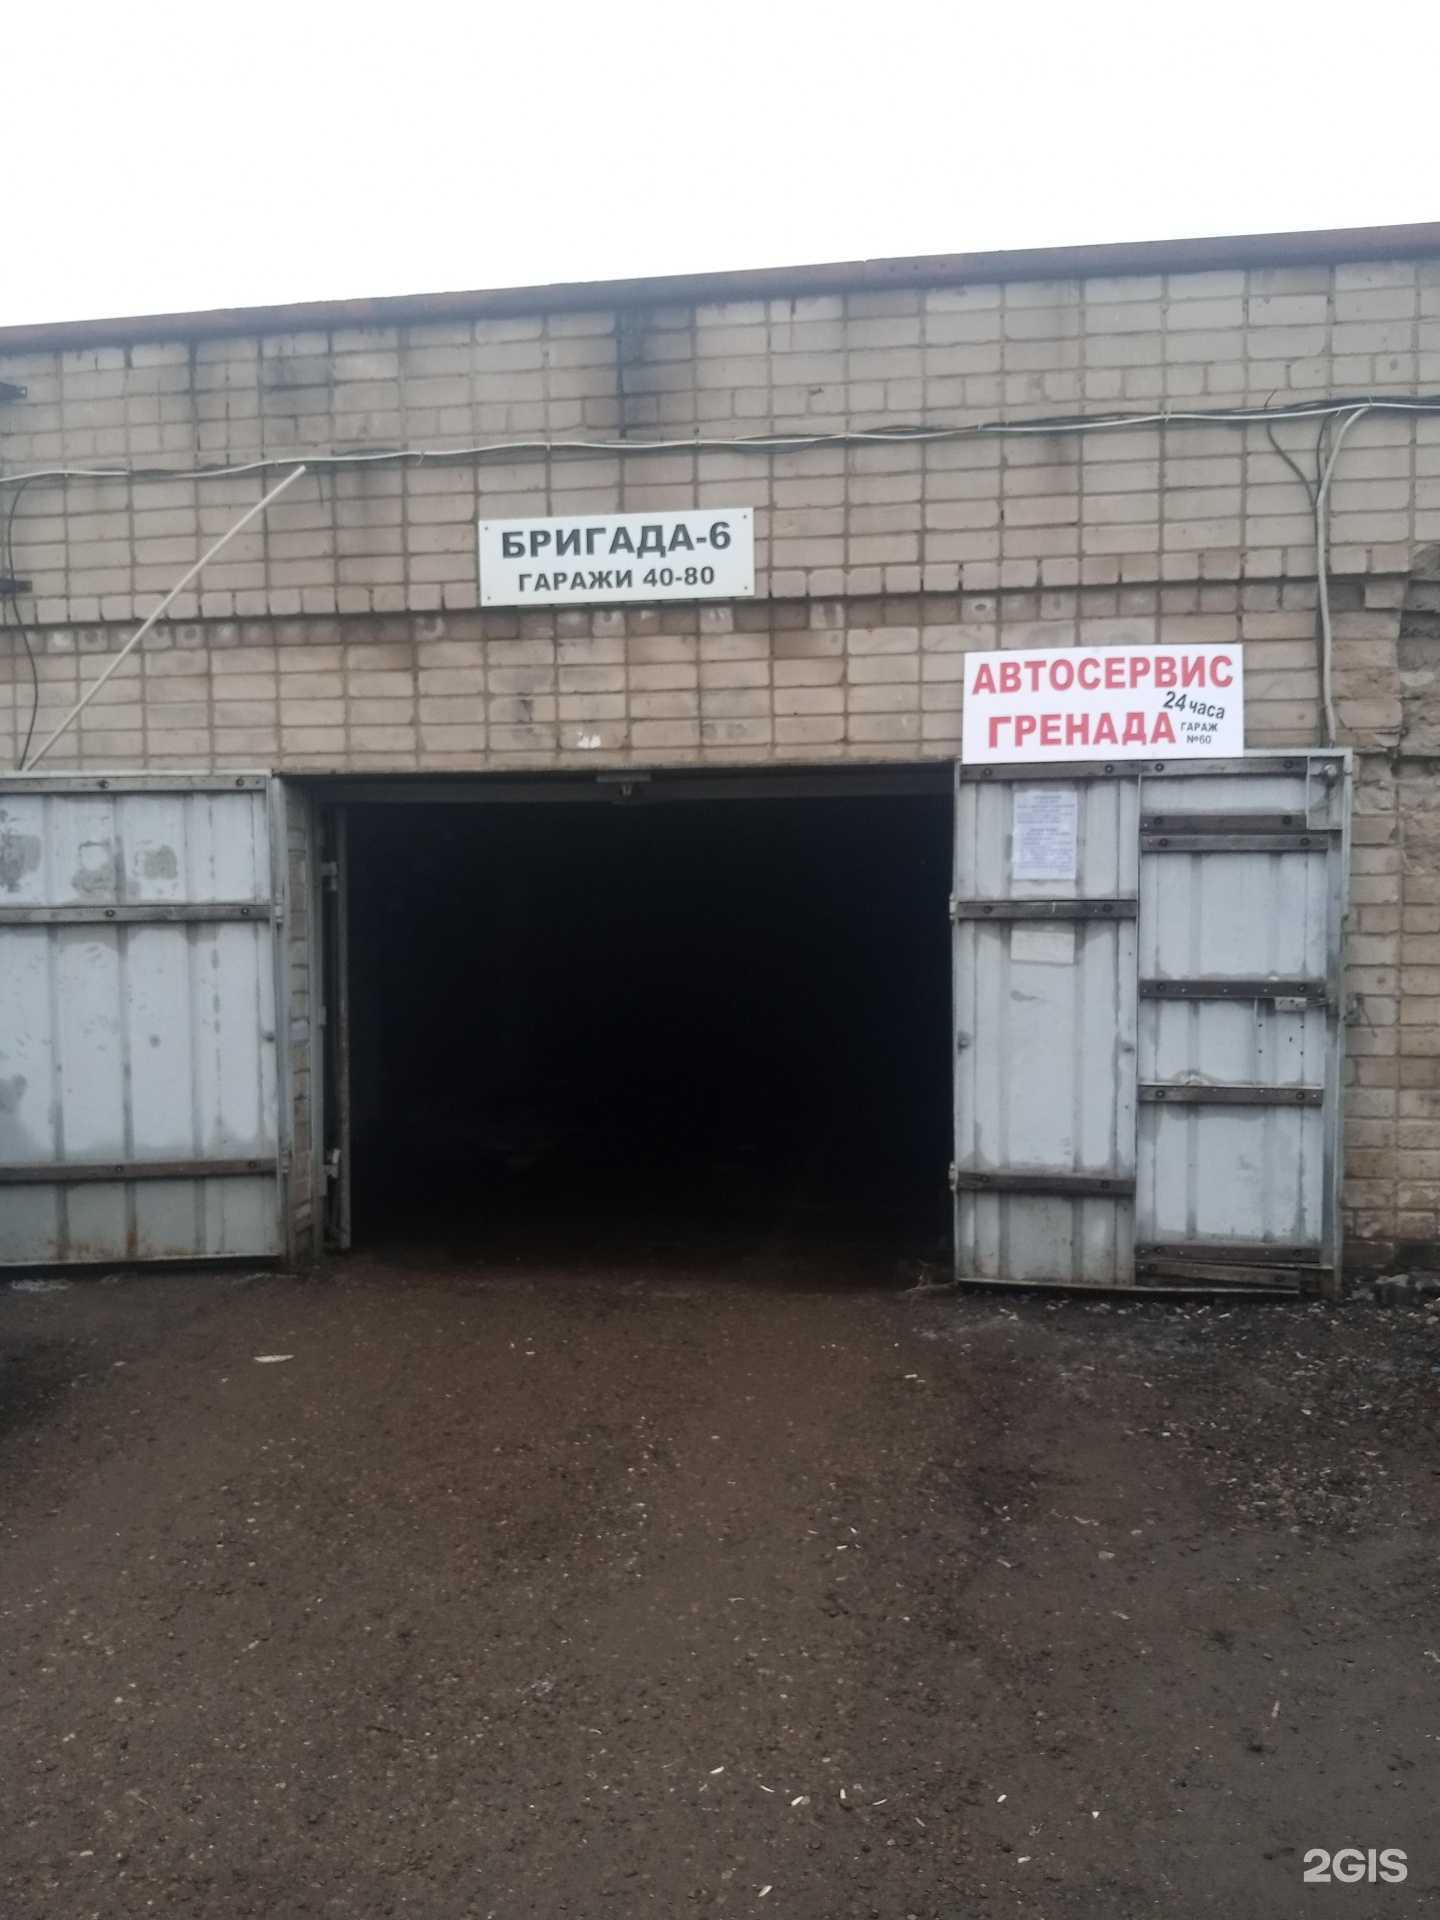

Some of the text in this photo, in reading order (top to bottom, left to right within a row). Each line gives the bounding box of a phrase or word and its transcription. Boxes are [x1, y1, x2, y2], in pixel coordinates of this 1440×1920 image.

[502, 522, 731, 559] БРИГАДА-6
[518, 566, 715, 592] ГАРАЖИ 40-80
[972, 655, 1234, 695] АВТОСЕРВИС
[1163, 691, 1225, 720] 24 часа
[988, 712, 1177, 749] ГРЕНАДА
[1180, 722, 1218, 732] ГАРАЖ
[1186, 734, 1212, 745] №60
